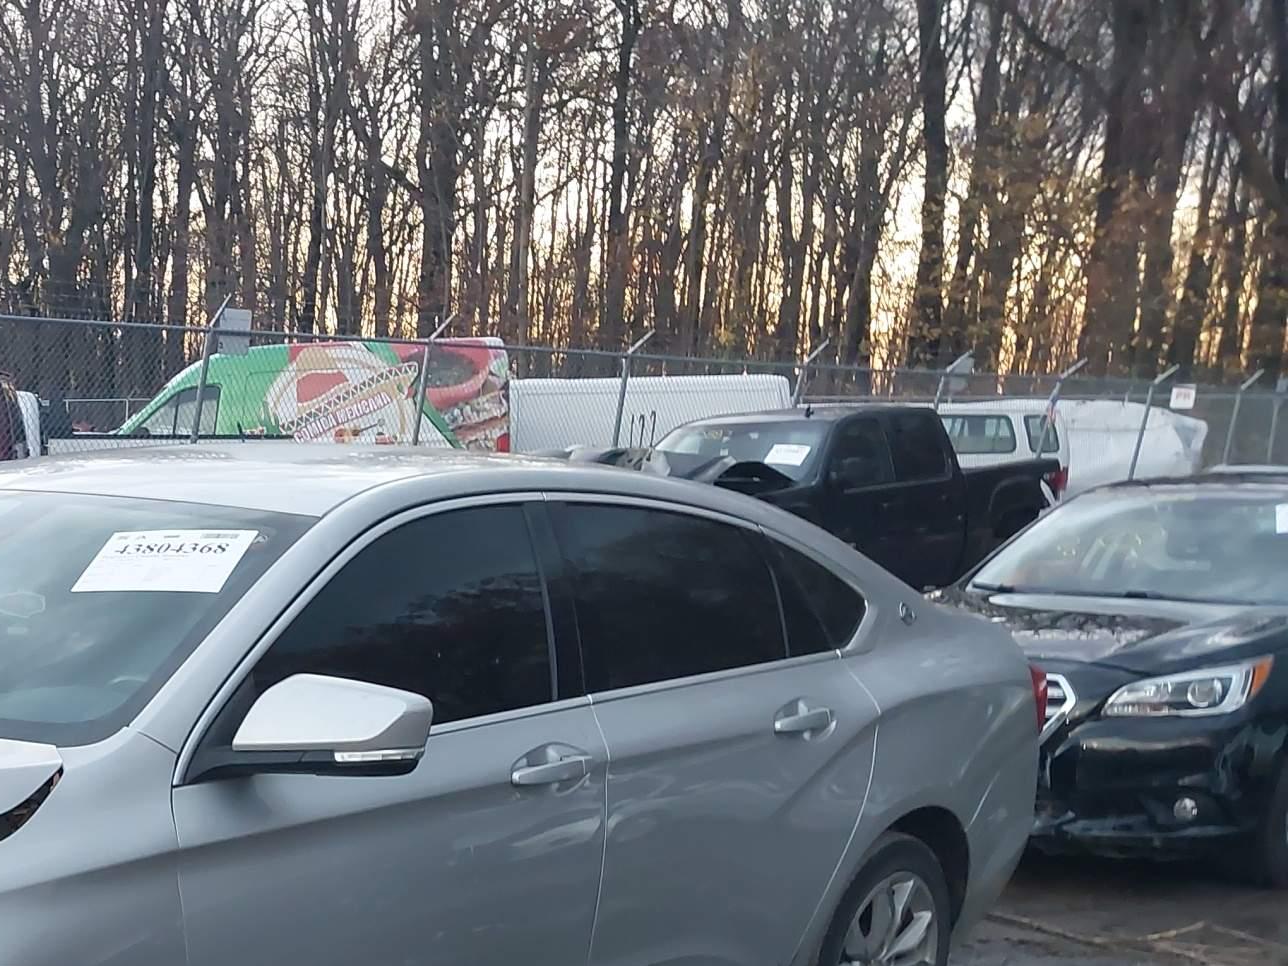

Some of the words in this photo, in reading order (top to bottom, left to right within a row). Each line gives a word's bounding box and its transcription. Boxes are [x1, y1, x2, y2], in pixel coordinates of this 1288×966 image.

[293, 413, 335, 443] COMIDA
[335, 392, 392, 424] MEXICANA
[115, 542, 230, 555] 43804368
